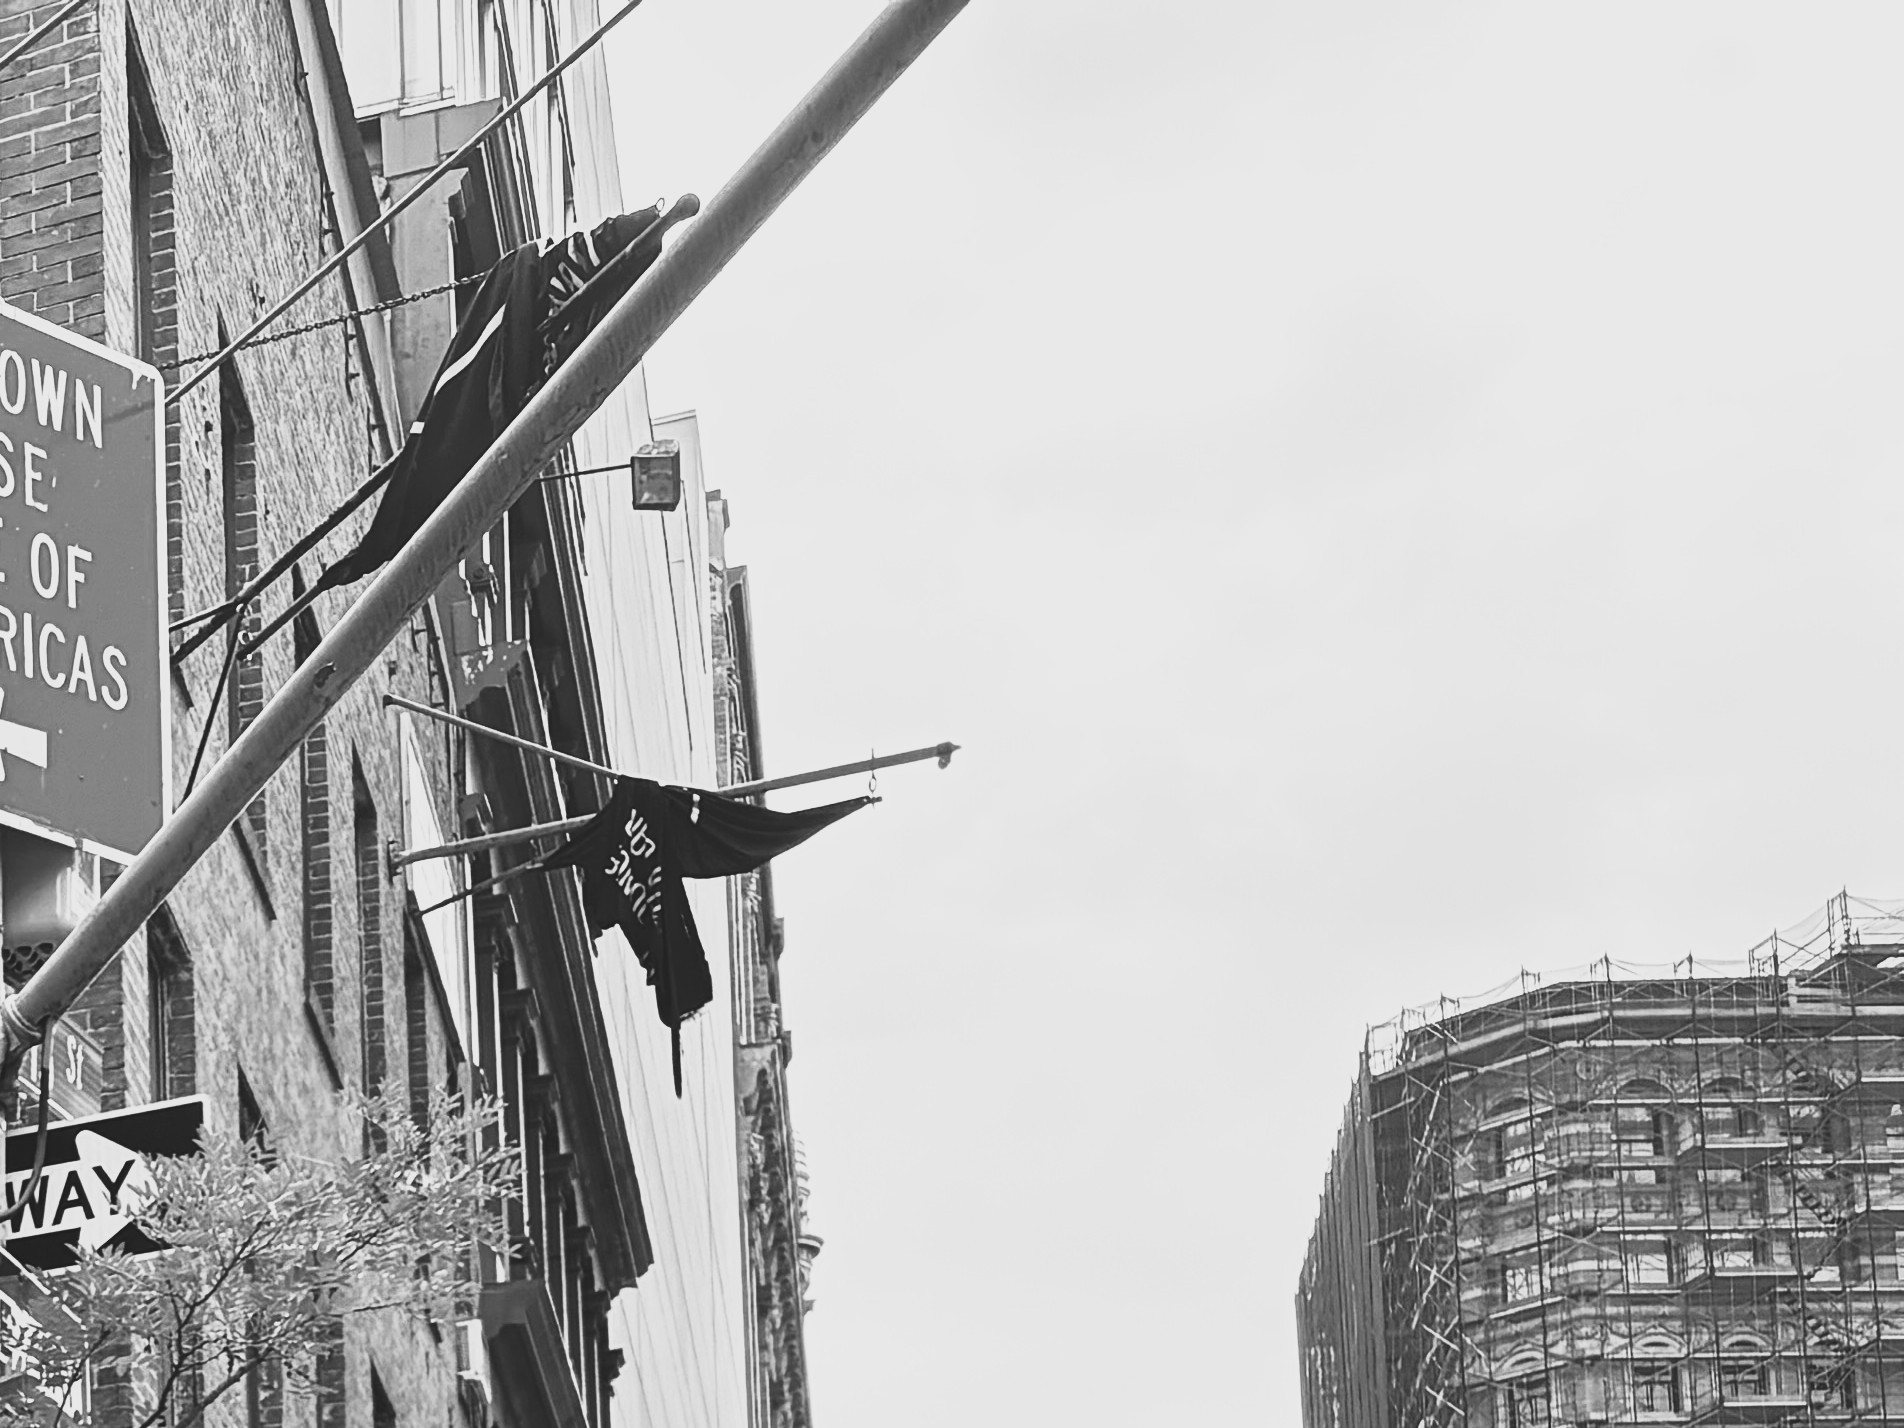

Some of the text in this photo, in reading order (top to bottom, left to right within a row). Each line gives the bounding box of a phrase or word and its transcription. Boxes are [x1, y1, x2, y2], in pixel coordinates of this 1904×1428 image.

[30, 532, 94, 609] OF
[65, 1034, 84, 1091] St
[6, 1158, 136, 1234] WAY
